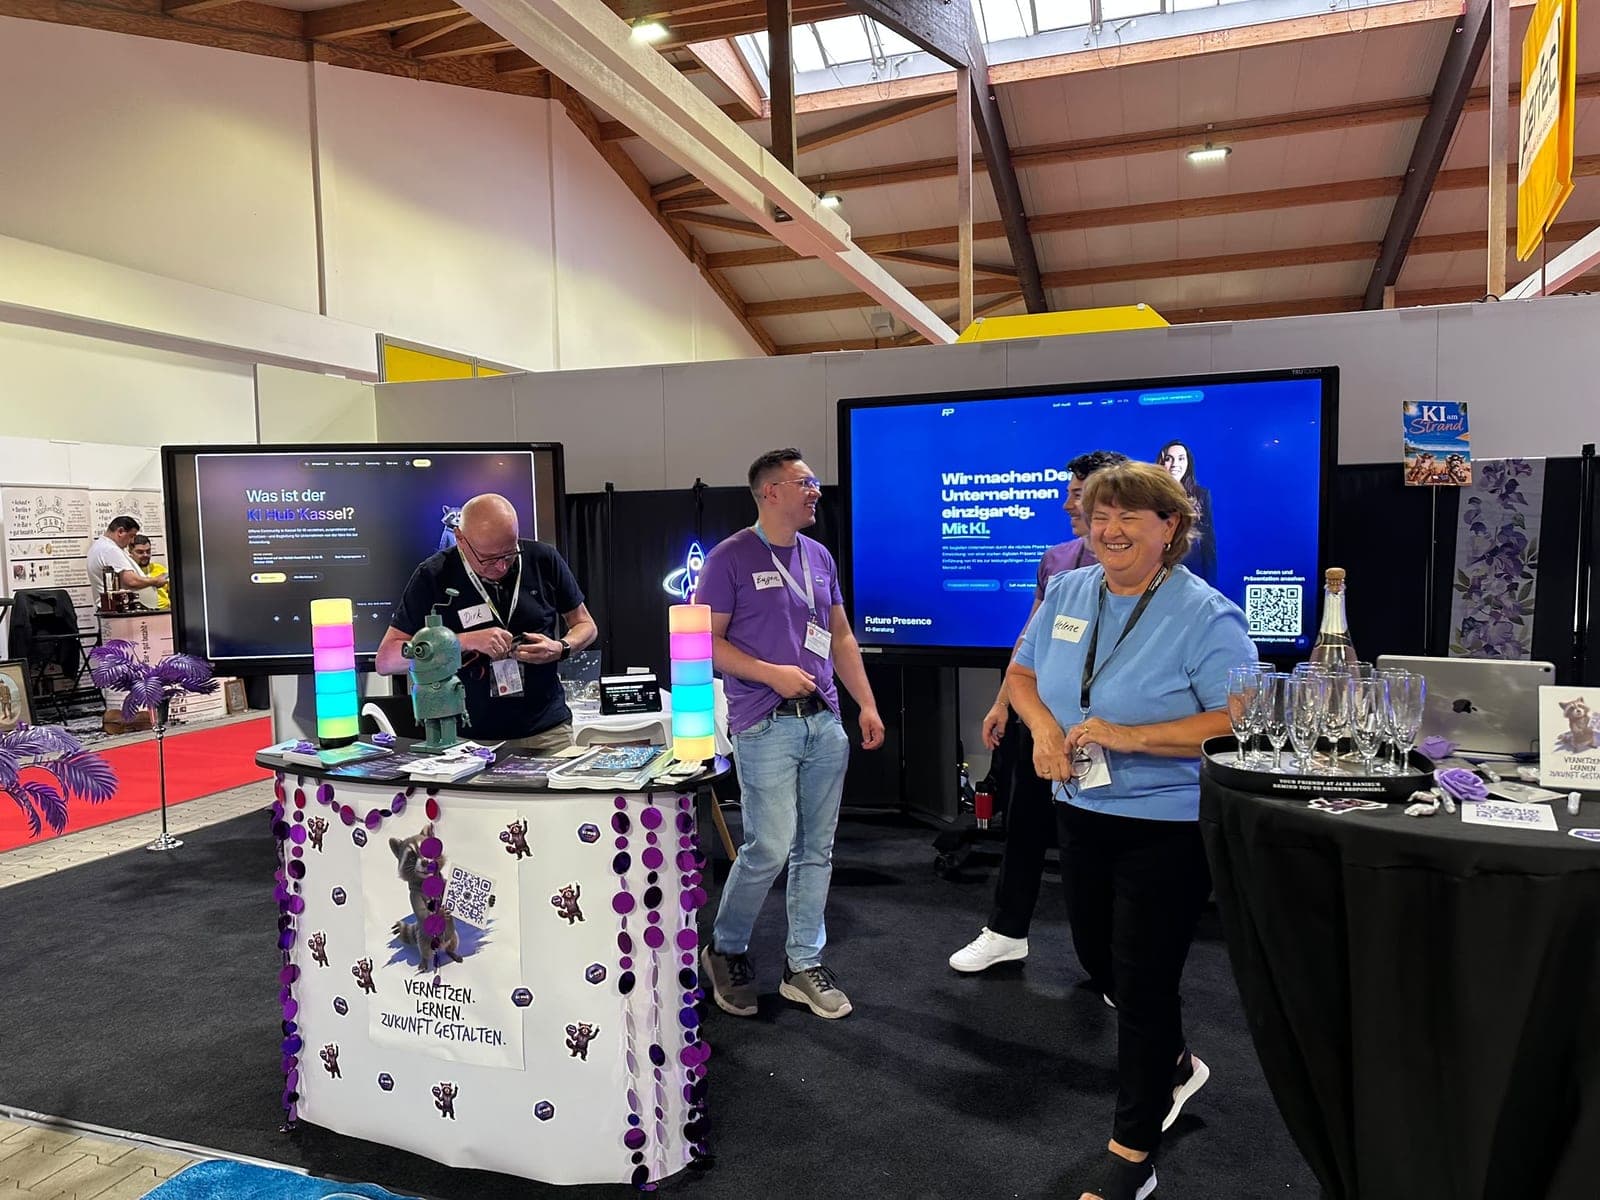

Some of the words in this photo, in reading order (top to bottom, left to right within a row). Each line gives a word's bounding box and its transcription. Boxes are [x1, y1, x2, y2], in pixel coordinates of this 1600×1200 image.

[1422, 405, 1446, 422] KI
[1409, 417, 1465, 435] Strand
[942, 472, 973, 485] Wir
[974, 470, 1042, 485] machen
[246, 489, 278, 503] Was
[281, 488, 299, 502] ist
[301, 488, 326, 502] der
[942, 487, 1059, 502] Unternehmen
[247, 508, 262, 522] KI
[266, 508, 296, 521] Hub
[299, 507, 355, 521] Kassel?
[942, 504, 1035, 520] einzigartig.
[942, 522, 969, 535] Mit
[464, 608, 482, 624] Dirk
[865, 616, 892, 625] Future
[892, 616, 932, 626] Presence
[404, 979, 476, 1004] VERNETZEN.
[416, 1000, 465, 1021] LERNEN.
[381, 1012, 433, 1035] ZUKUNFT
[434, 1021, 507, 1046] GESTALTEN.
